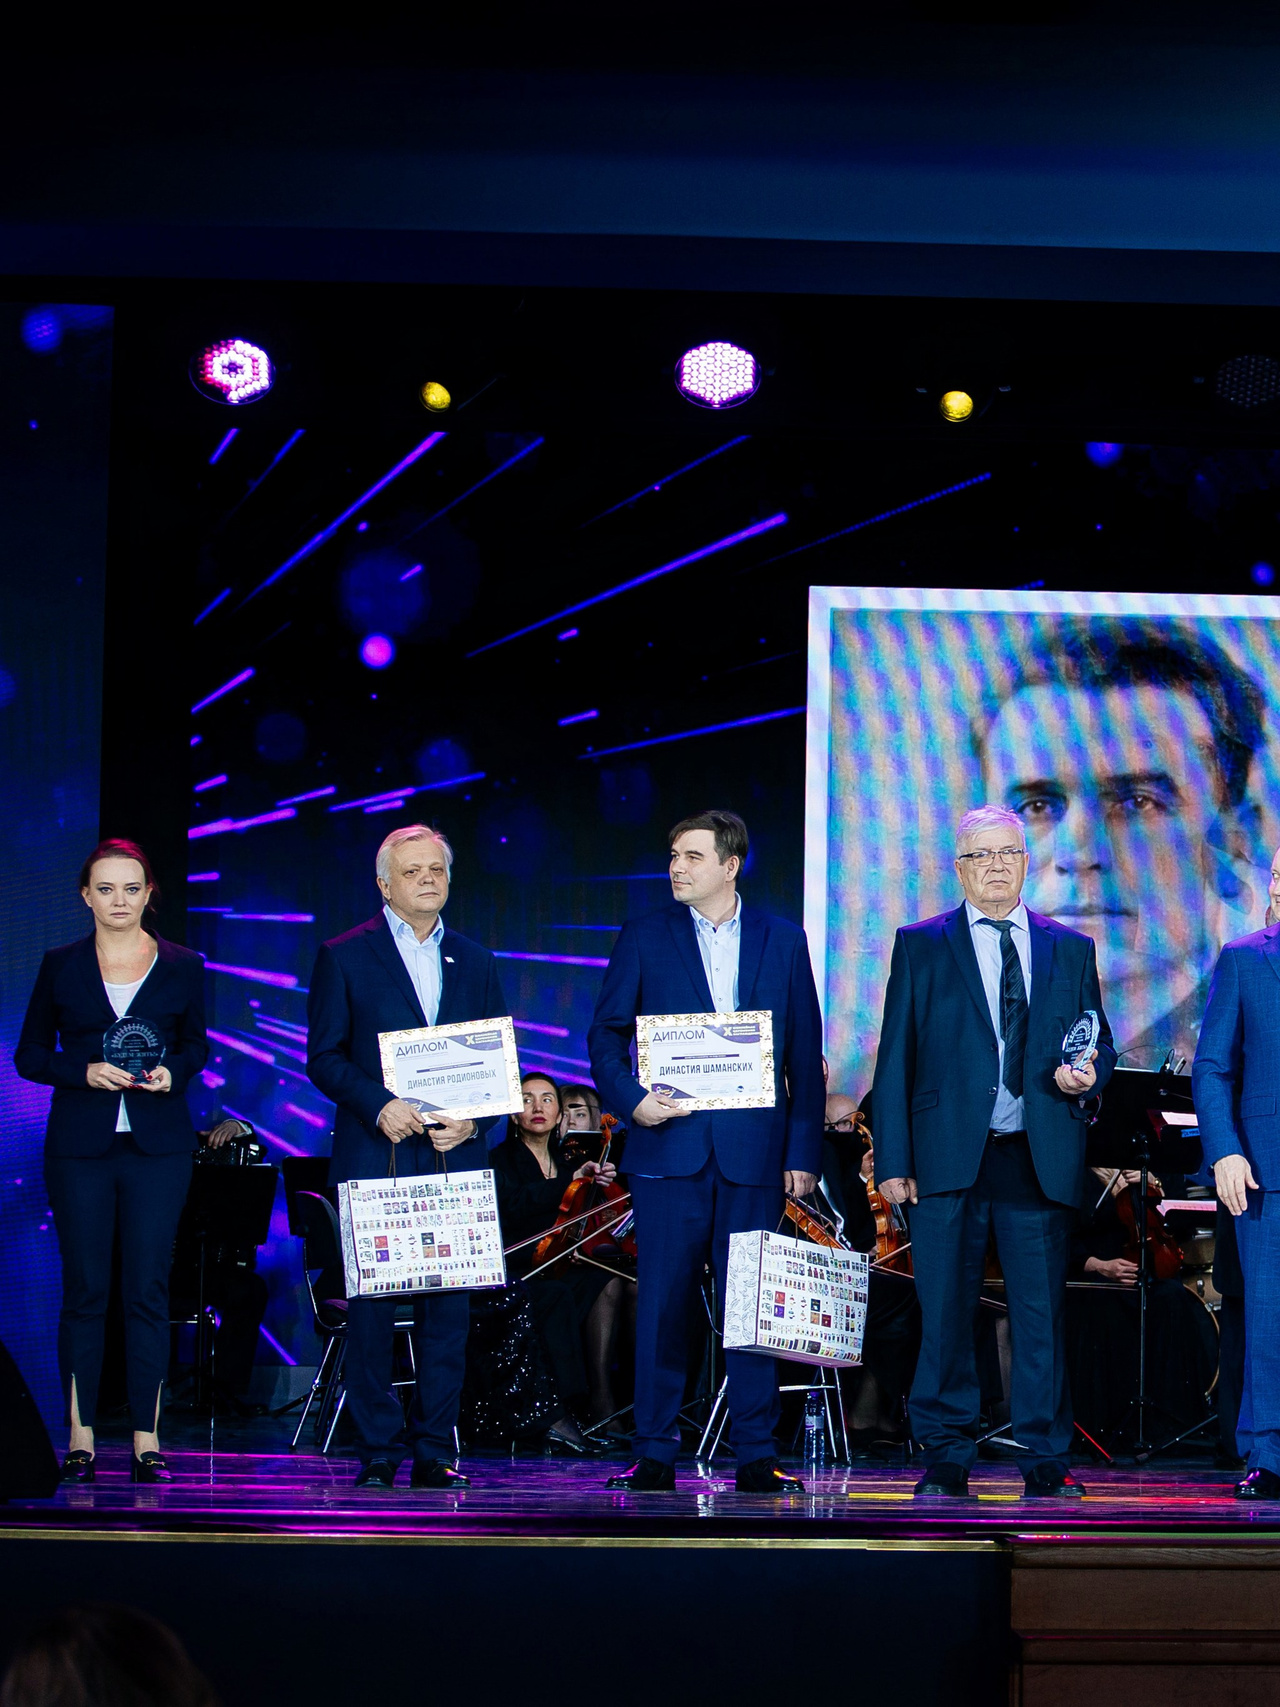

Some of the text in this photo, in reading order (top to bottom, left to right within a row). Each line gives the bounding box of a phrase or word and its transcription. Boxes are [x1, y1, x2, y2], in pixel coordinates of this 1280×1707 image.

[653, 1030, 705, 1042] ДИПЛОМ
[396, 1041, 448, 1057] ДИПЛОМ
[659, 1062, 754, 1077] ДИНАСТИЯ ШАМАНСКИХ
[407, 1075, 446, 1090] ДИНАСТИЯ
[447, 1069, 497, 1083] РОДИОНОВЫХ
